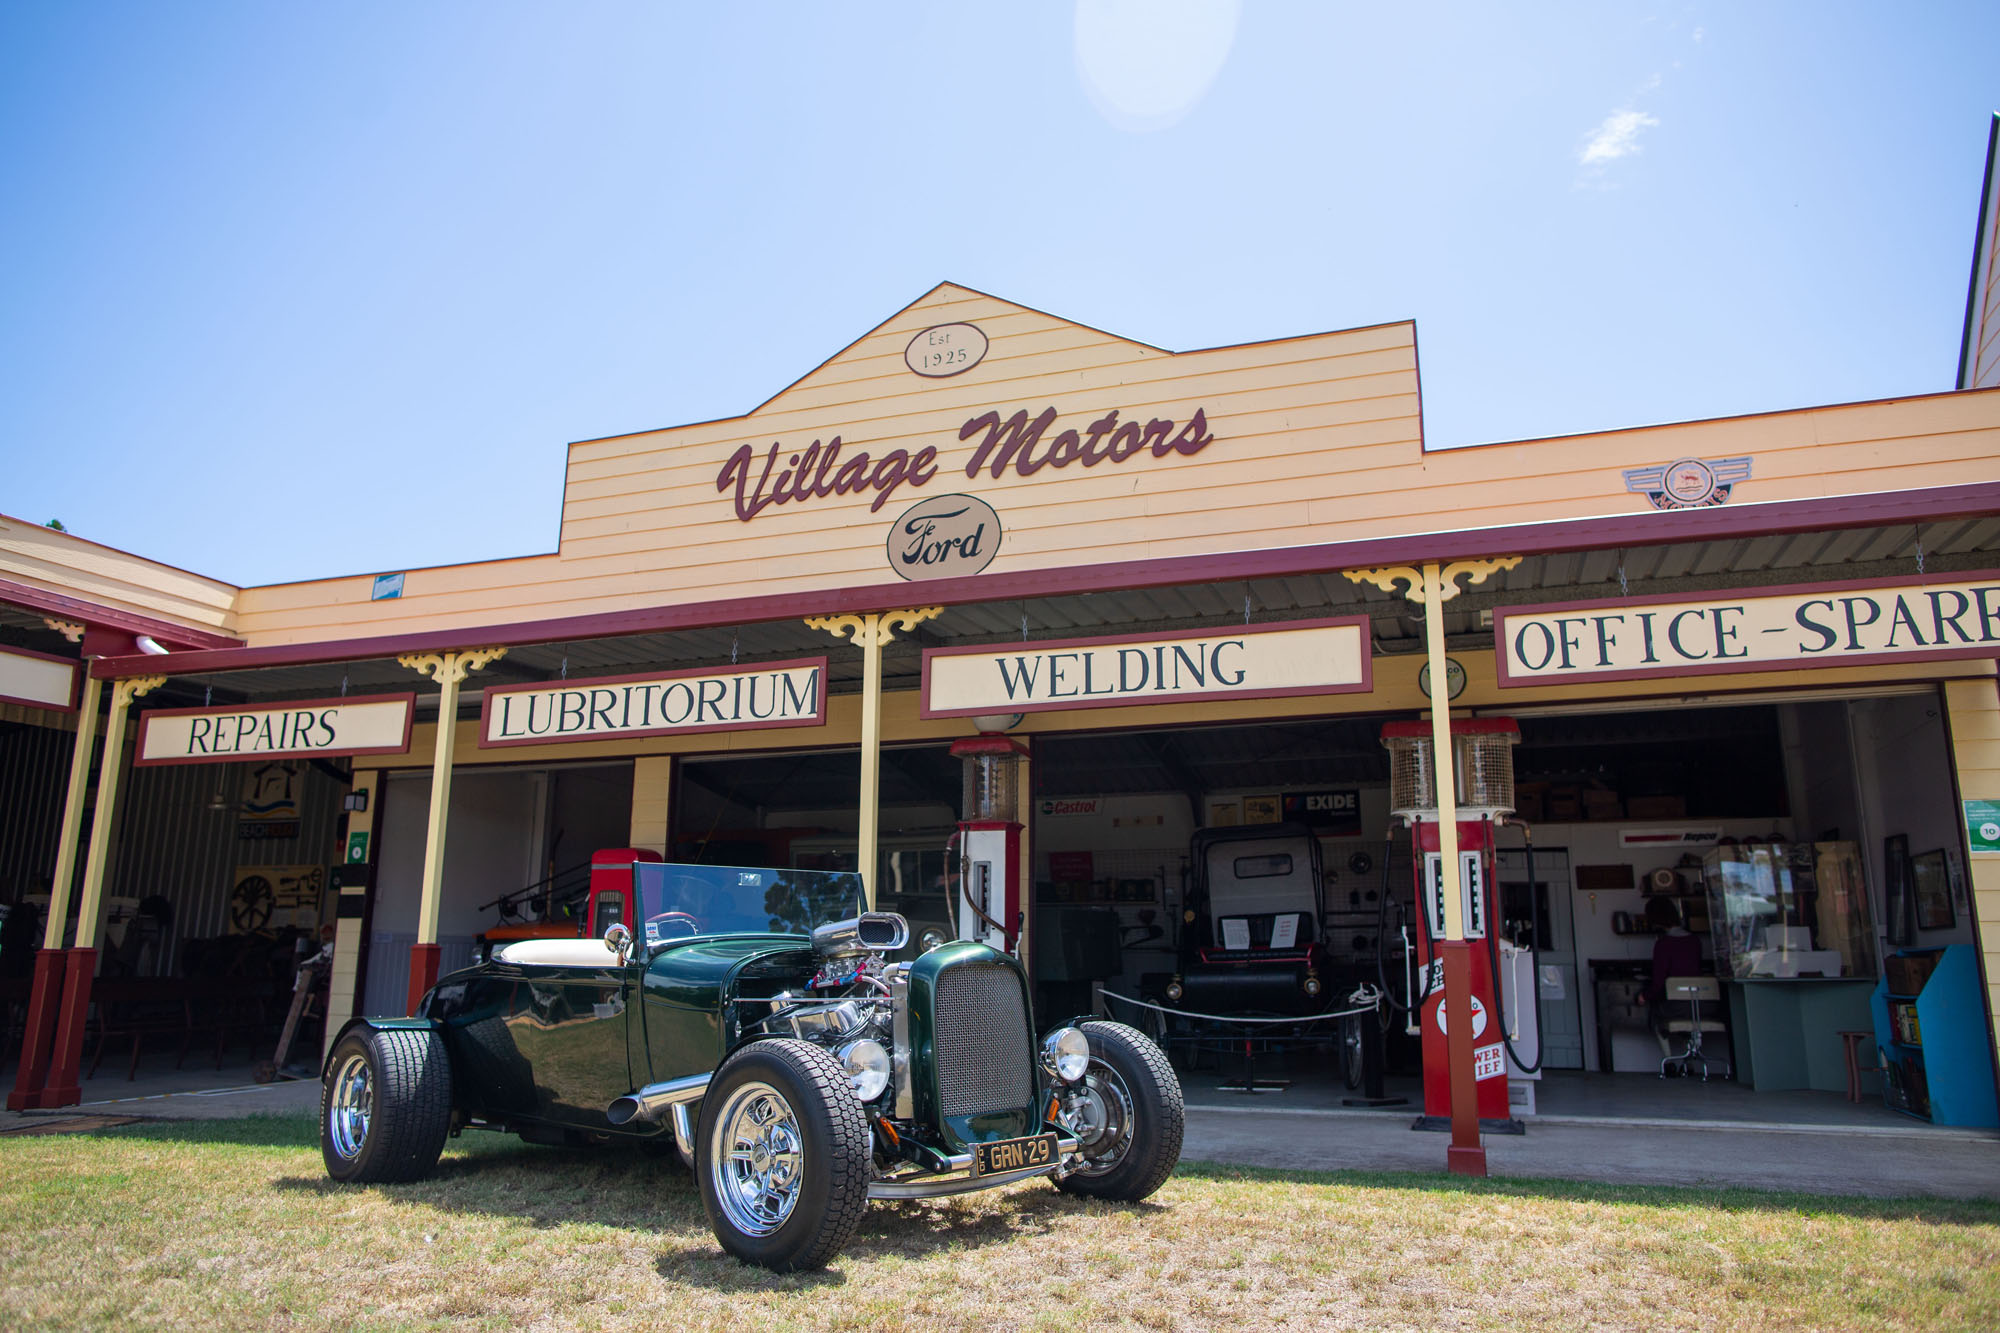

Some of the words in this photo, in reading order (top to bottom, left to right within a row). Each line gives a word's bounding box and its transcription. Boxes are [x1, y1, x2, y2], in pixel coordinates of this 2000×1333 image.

[923, 348, 968, 369] 1925
[928, 331, 951, 346] Est
[716, 435, 939, 522] Village
[958, 405, 1214, 479] Motors
[902, 506, 984, 566] Ford
[995, 640, 1247, 700] WELDING
[499, 668, 819, 737] LUBRITORIUM
[187, 709, 339, 754] REPAIRS
[1055, 800, 1097, 815] Castrol
[1306, 794, 1356, 811] EXIDE
